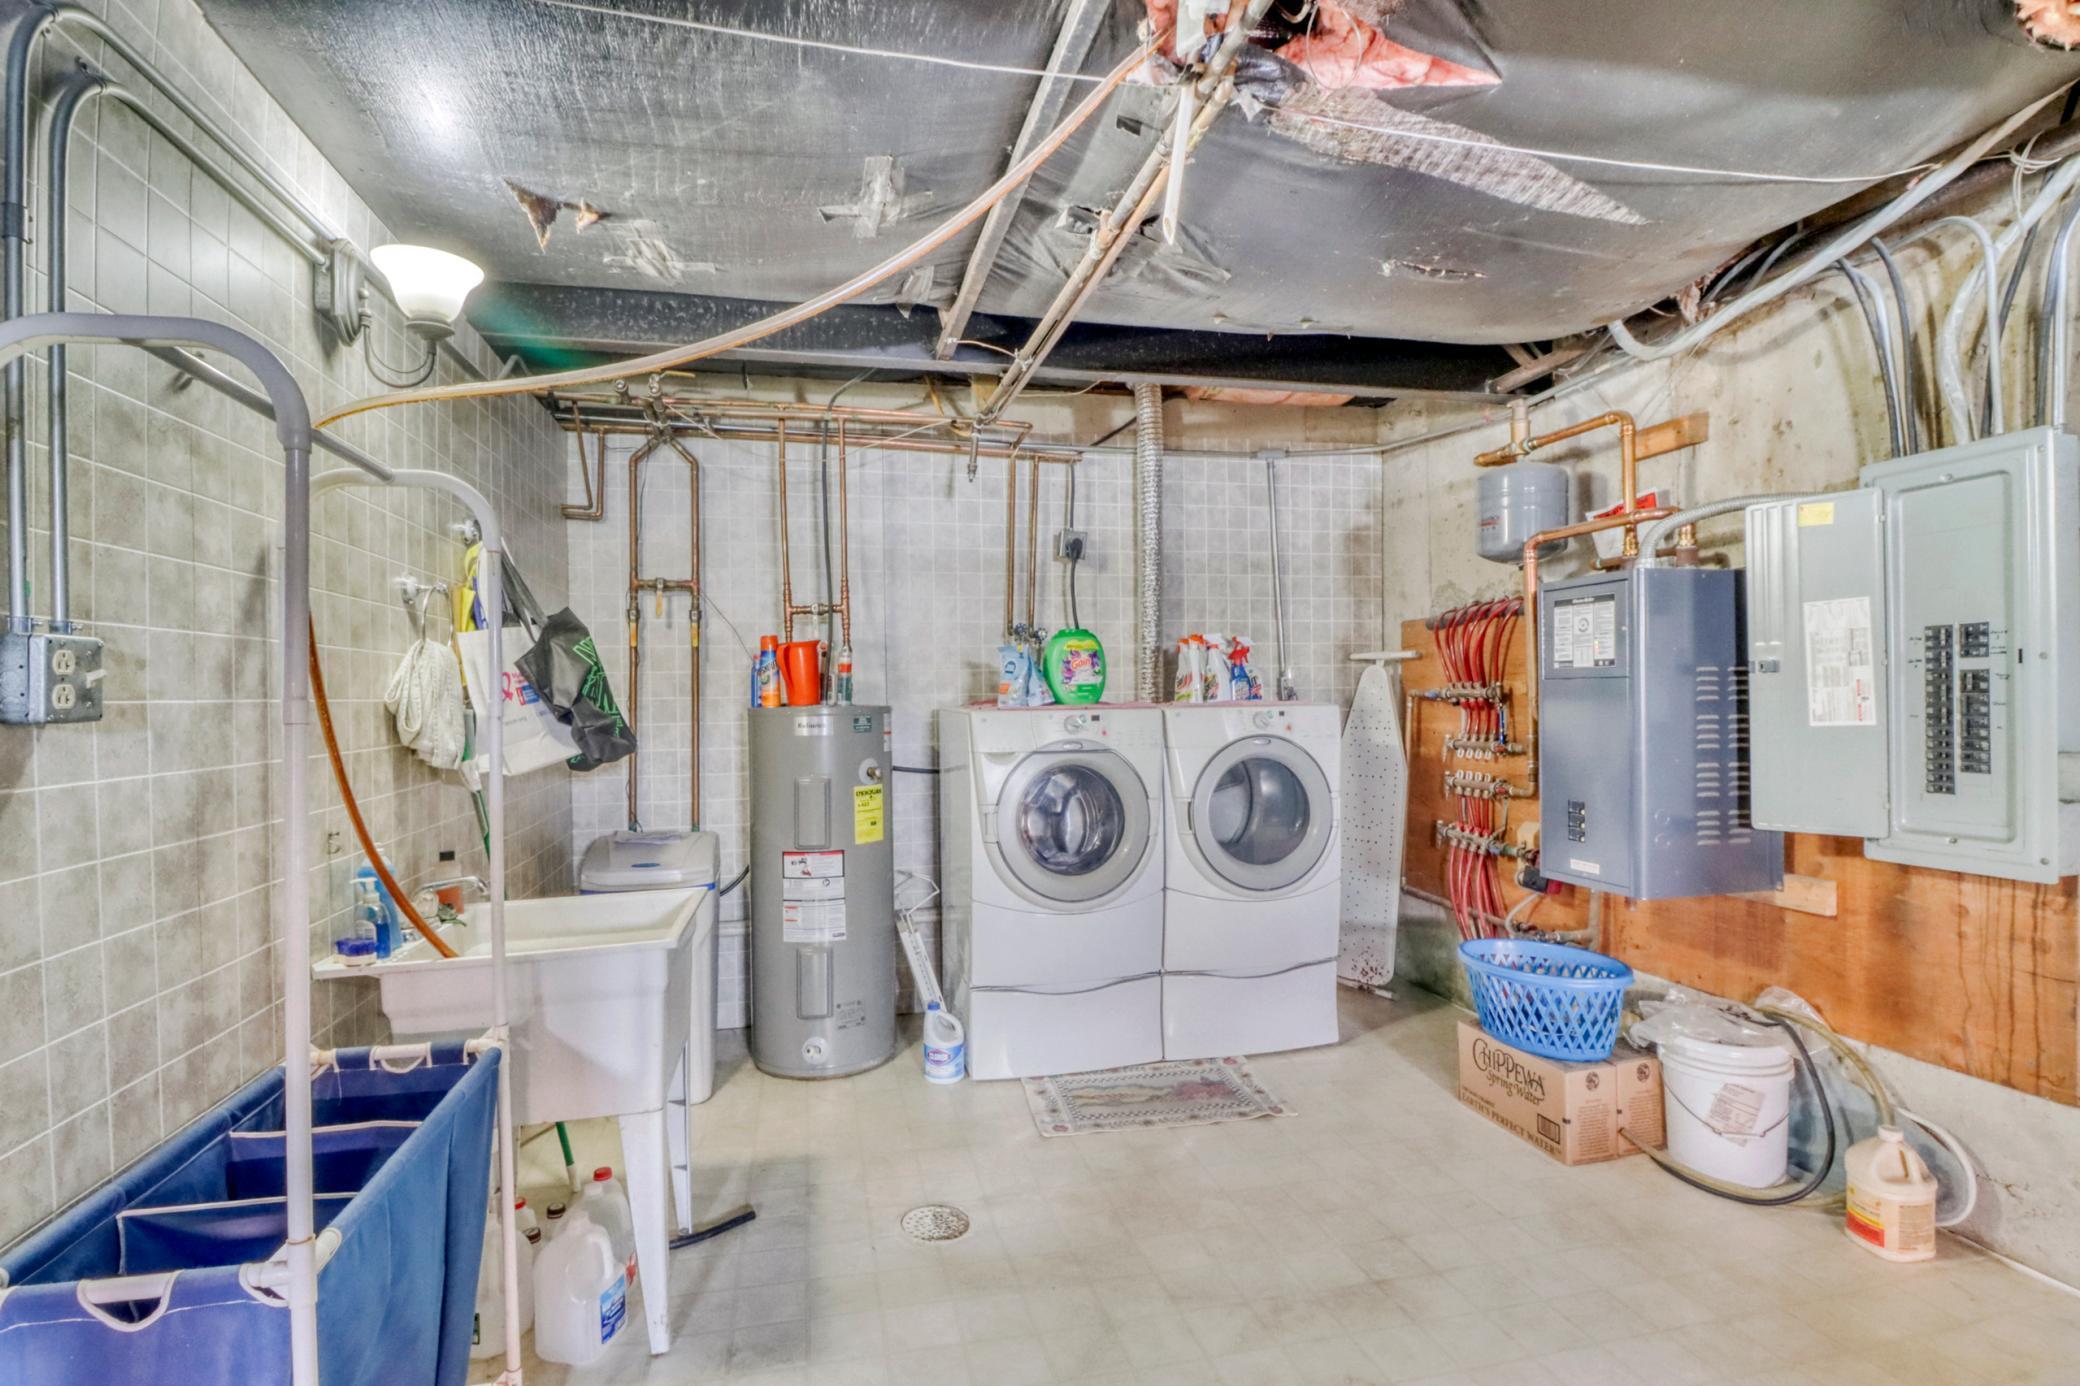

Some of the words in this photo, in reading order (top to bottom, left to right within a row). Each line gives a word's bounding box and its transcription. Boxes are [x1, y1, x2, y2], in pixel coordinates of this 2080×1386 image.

[1473, 1038, 1546, 1097] CHIPPEWA
[1487, 1069, 1515, 1097] Spring
[1514, 1083, 1545, 1106] Water
[1491, 1110, 1525, 1136] PERFECT
